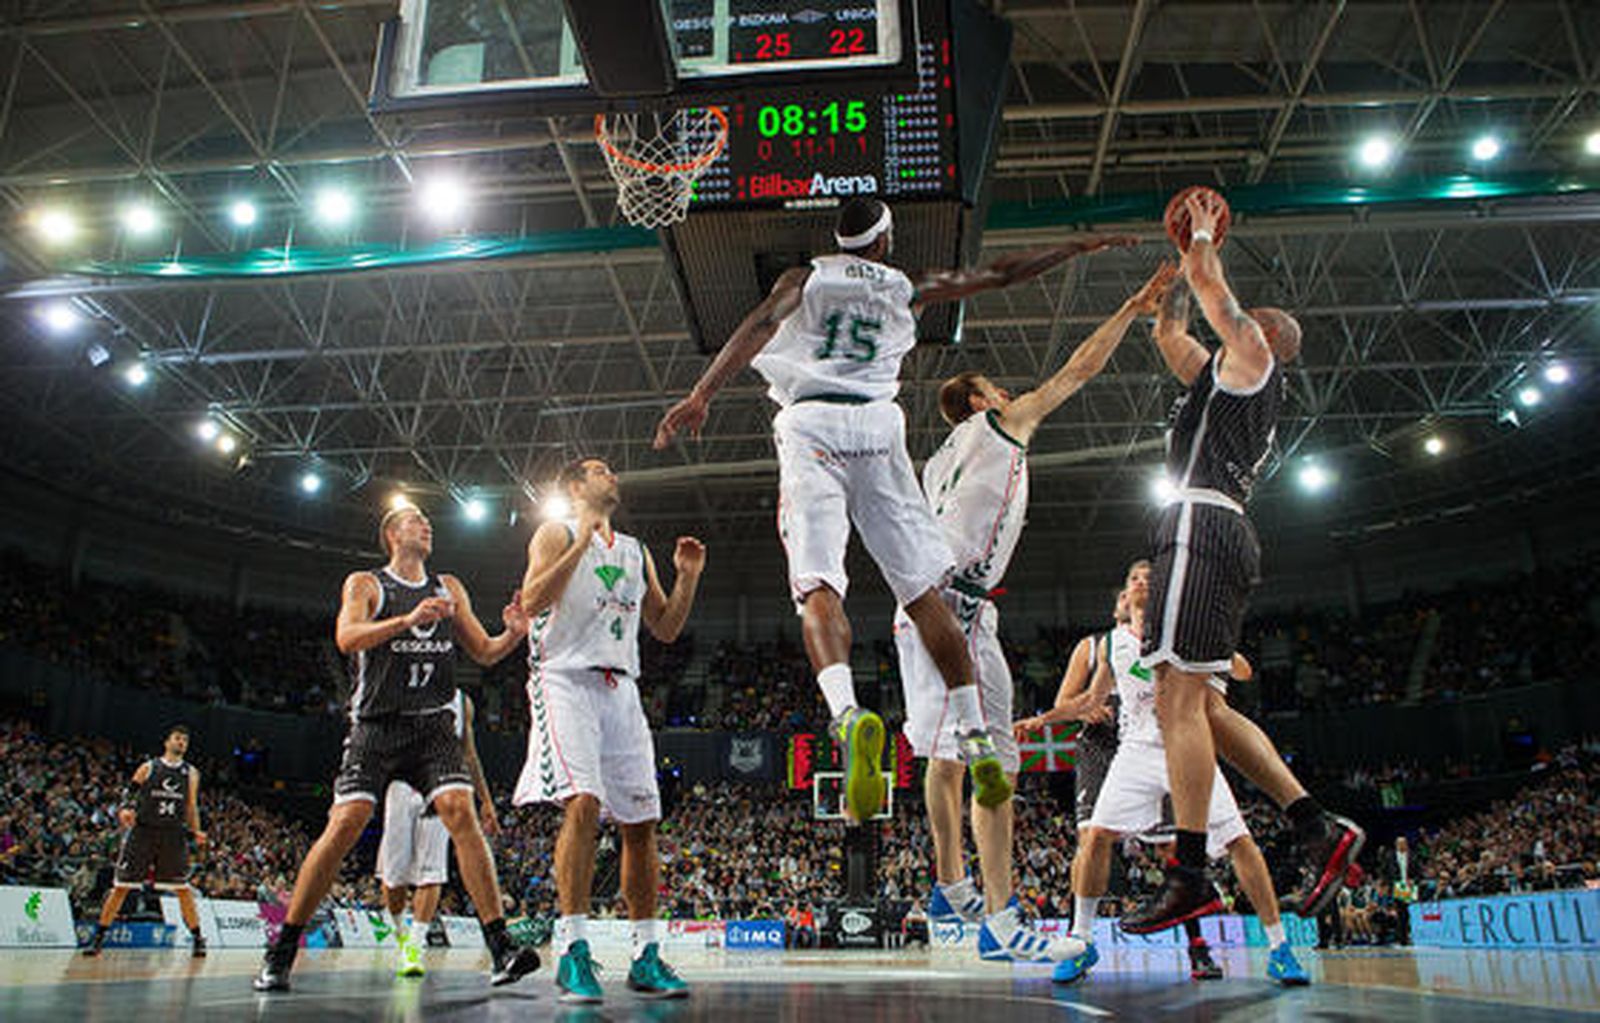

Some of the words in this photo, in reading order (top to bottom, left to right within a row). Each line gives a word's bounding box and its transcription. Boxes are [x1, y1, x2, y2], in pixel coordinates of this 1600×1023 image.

[755, 33, 791, 58] 25
[829, 28, 865, 54] 22
[758, 101, 867, 137] 08:15
[815, 307, 881, 362] 15
[610, 616, 623, 640] 4
[408, 663, 434, 687] 17
[1459, 898, 1596, 944] ERCILL
[743, 930, 781, 943] IMQ
